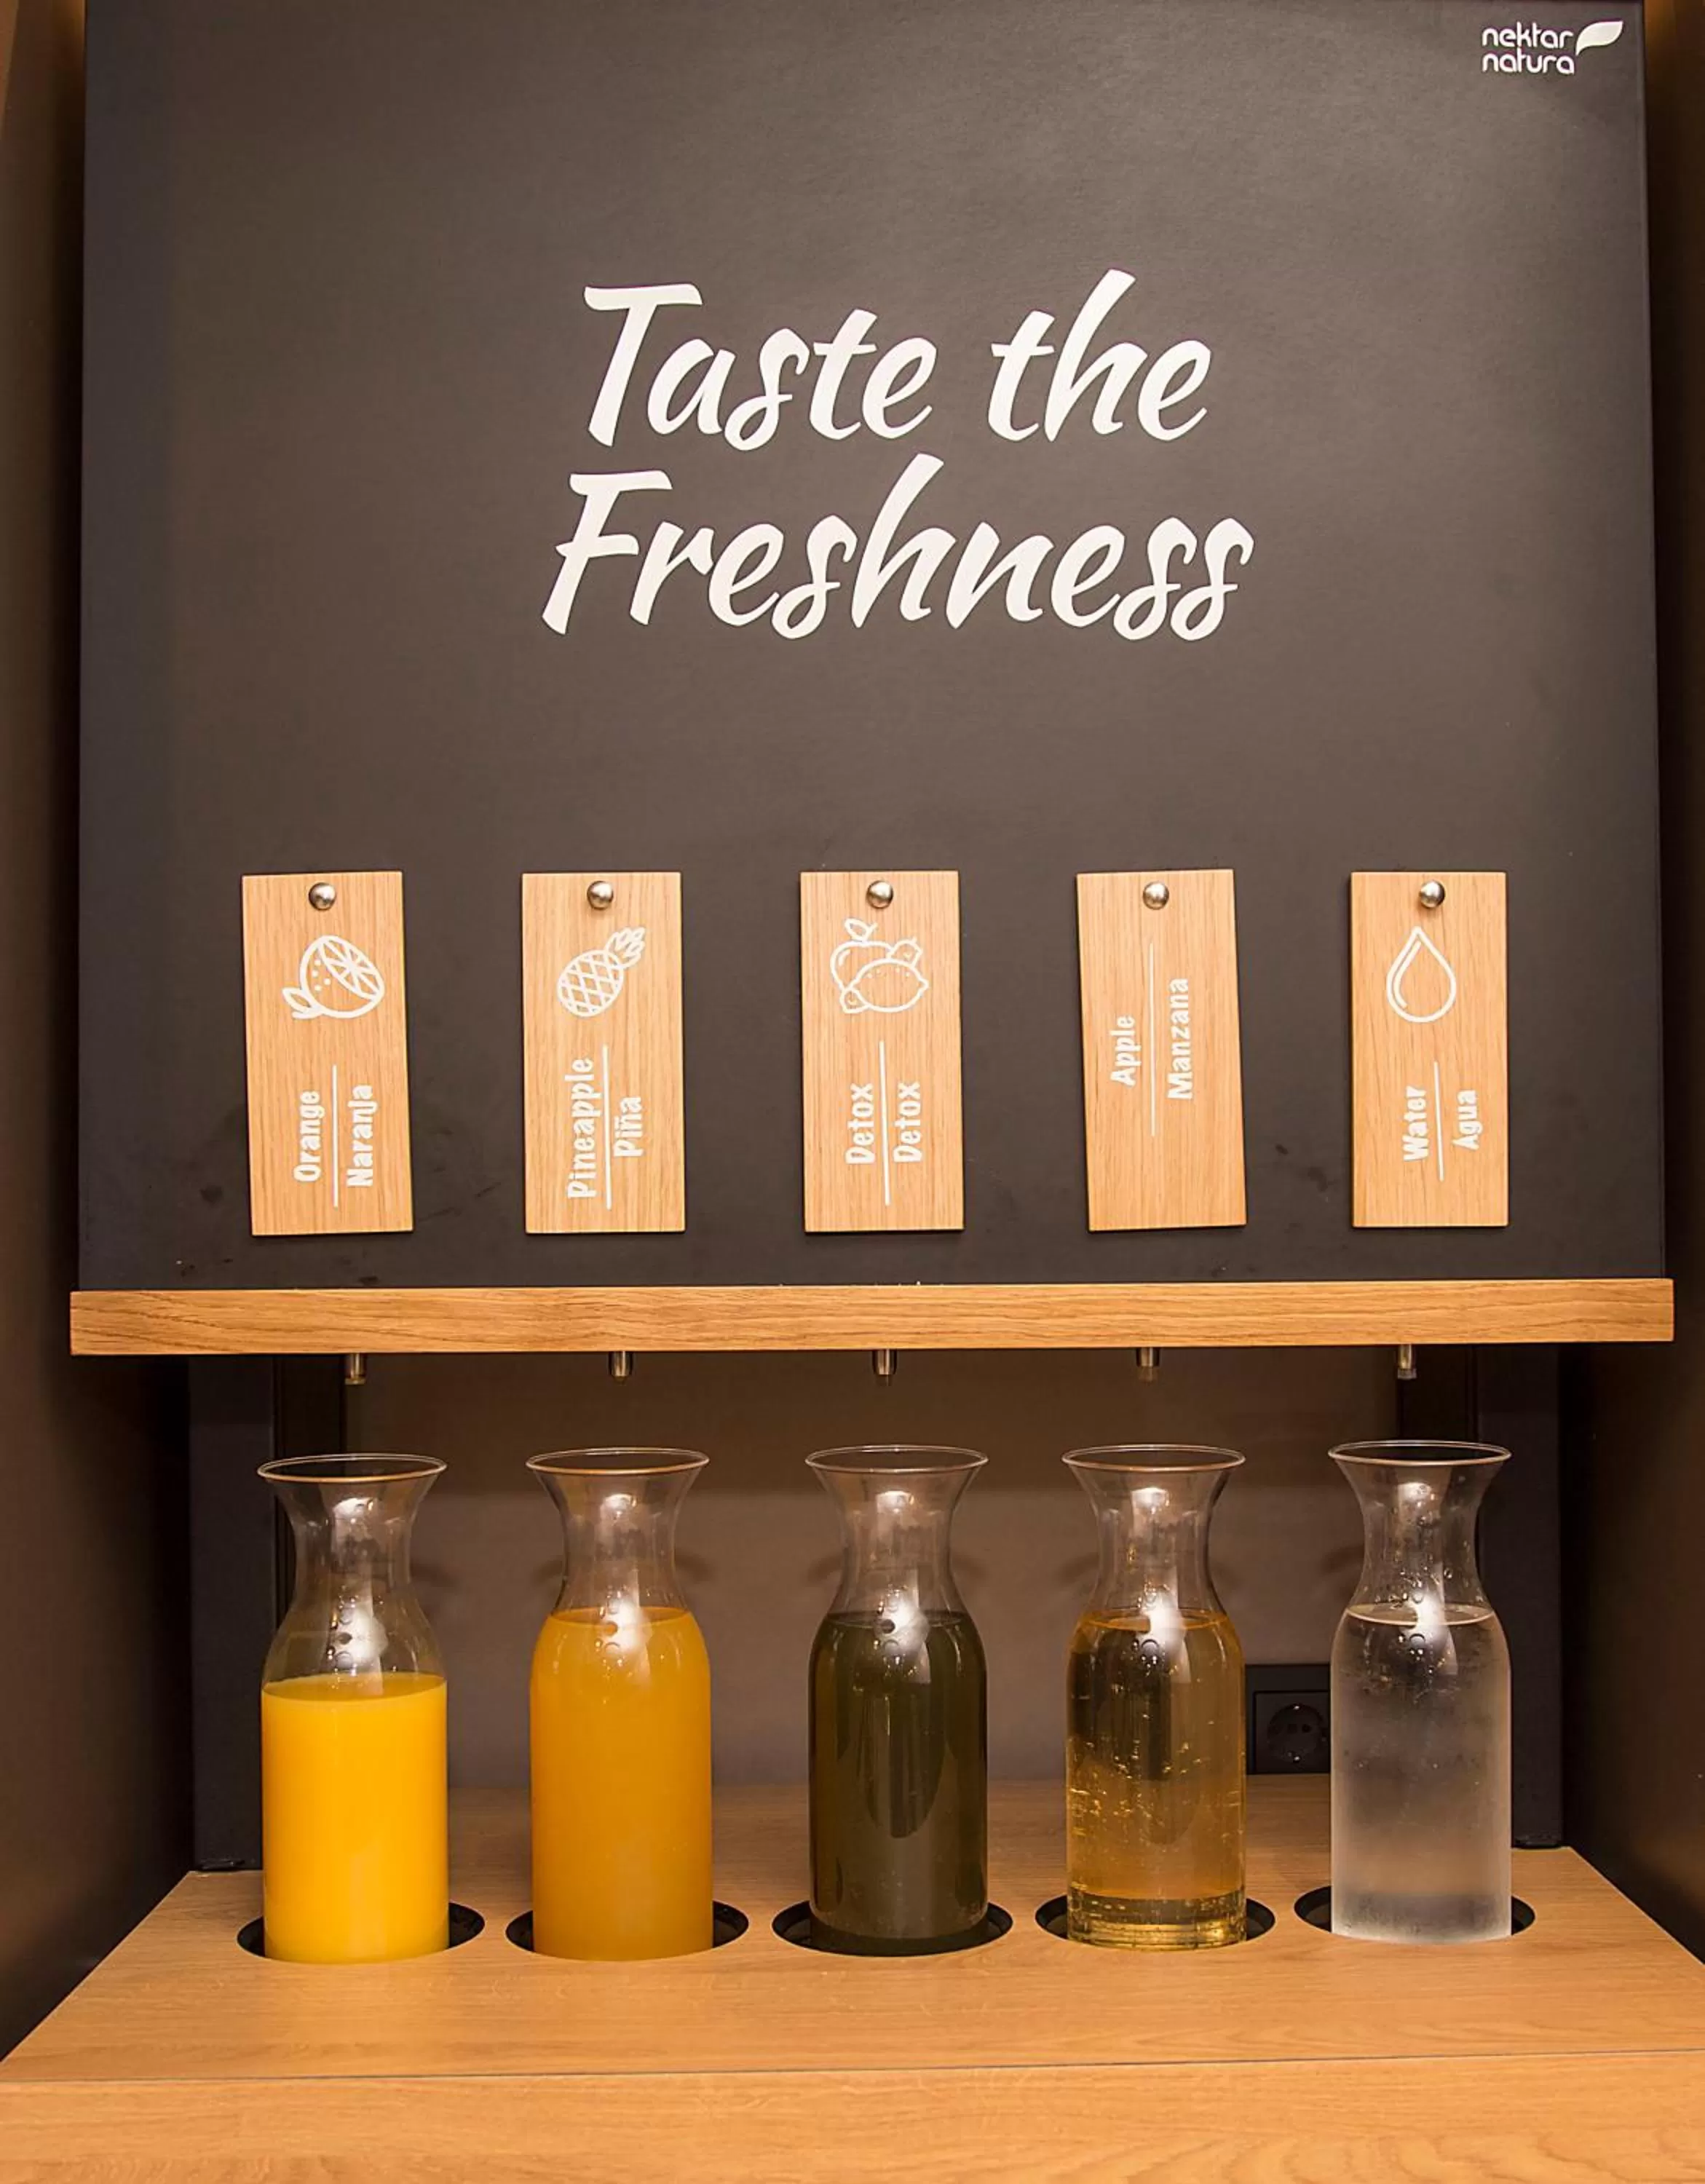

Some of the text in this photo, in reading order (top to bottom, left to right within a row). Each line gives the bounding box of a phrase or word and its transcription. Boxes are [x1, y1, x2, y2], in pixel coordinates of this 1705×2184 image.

[1482, 21, 1575, 49] nektar
[1482, 47, 1575, 74] natura
[584, 269, 1211, 451] Taste the
[541, 453, 1255, 641] Freshness
[1109, 1015, 1142, 1088] Apple
[1166, 977, 1193, 1100] Manzana
[293, 1091, 325, 1182] Orange
[346, 1084, 379, 1187] Naranja
[563, 1057, 599, 1199] Pineapple
[613, 1096, 644, 1158] Piña
[844, 1083, 876, 1165] Detox
[893, 1081, 924, 1163] Detox
[1402, 1085, 1429, 1162] Water
